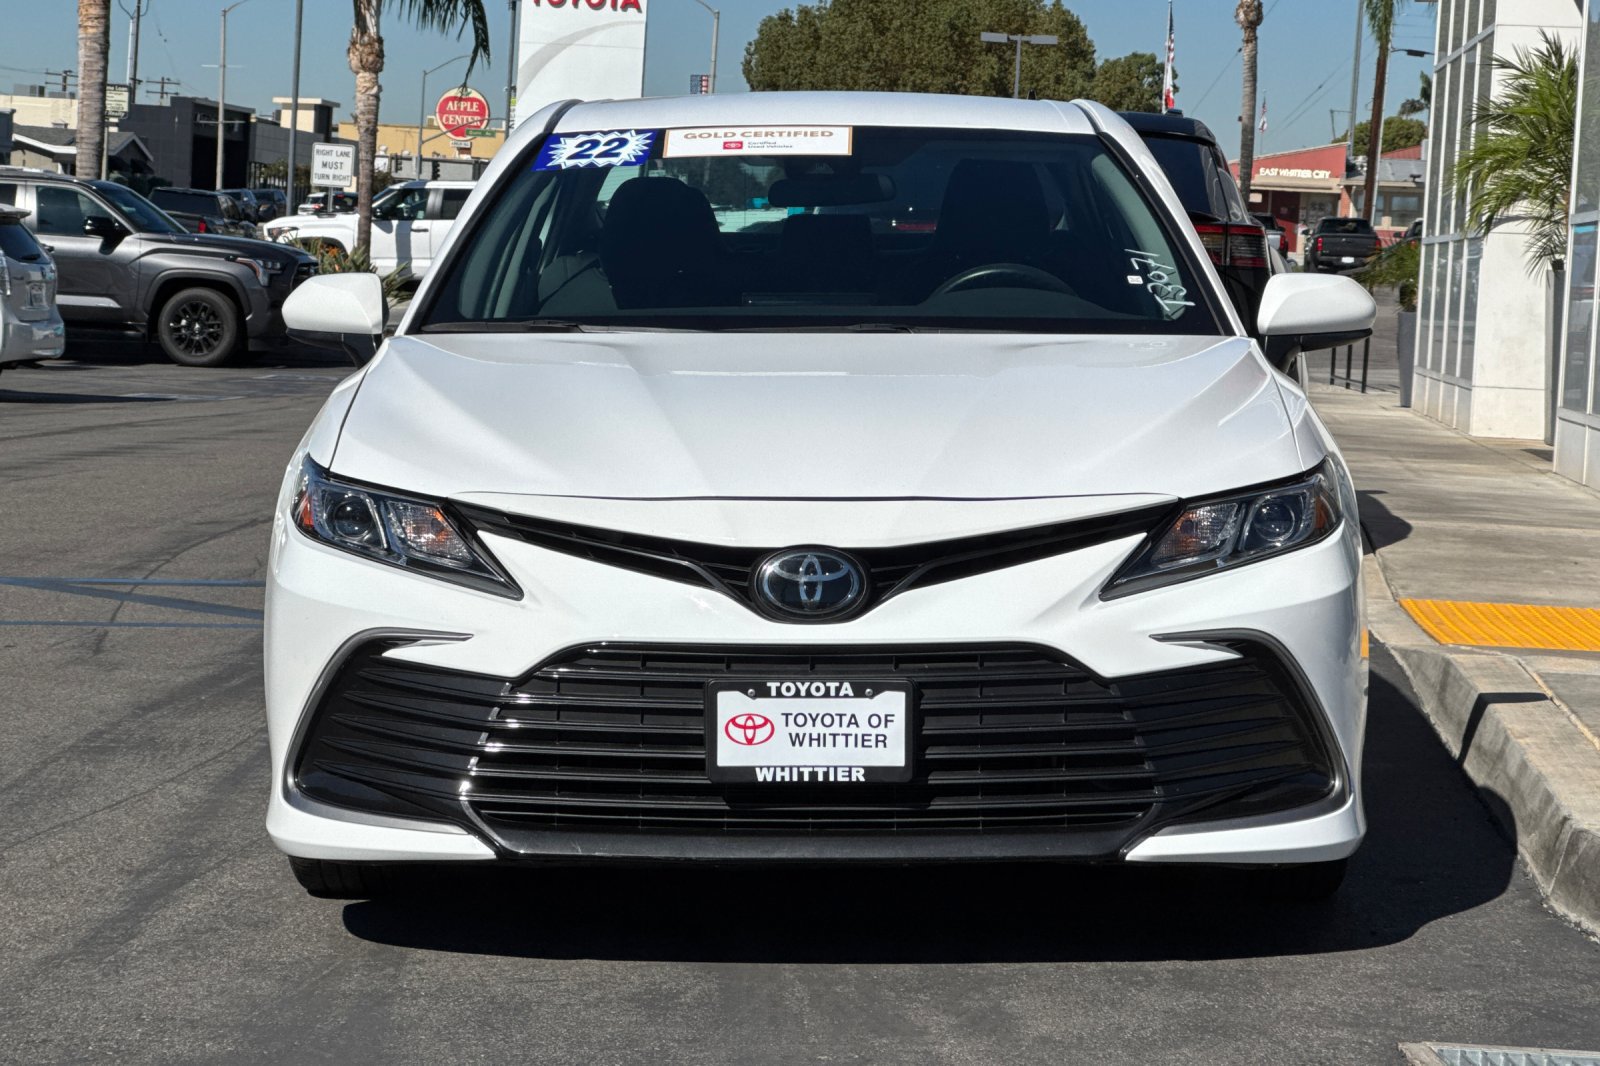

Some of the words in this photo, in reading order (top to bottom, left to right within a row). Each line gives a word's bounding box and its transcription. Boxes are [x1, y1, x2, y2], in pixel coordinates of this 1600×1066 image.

[533, 0, 643, 12] OTA
[446, 101, 480, 112] APPLE
[442, 114, 481, 126] CENTER
[684, 131, 736, 139] GOLD
[316, 149, 334, 157] RIGHT
[336, 150, 351, 158] LANE
[566, 137, 629, 160] 22
[321, 160, 344, 170] MUST
[314, 172, 330, 180] TURN
[332, 173, 350, 181] RIGHT
[1259, 167, 1278, 176] EAST
[1312, 170, 1331, 179] CITY
[766, 681, 854, 697] TOYOTA
[781, 712, 860, 728] TOYOTA
[867, 713, 896, 729] OF
[788, 732, 888, 749] WHITTIER
[755, 767, 866, 782] WHITTIER
